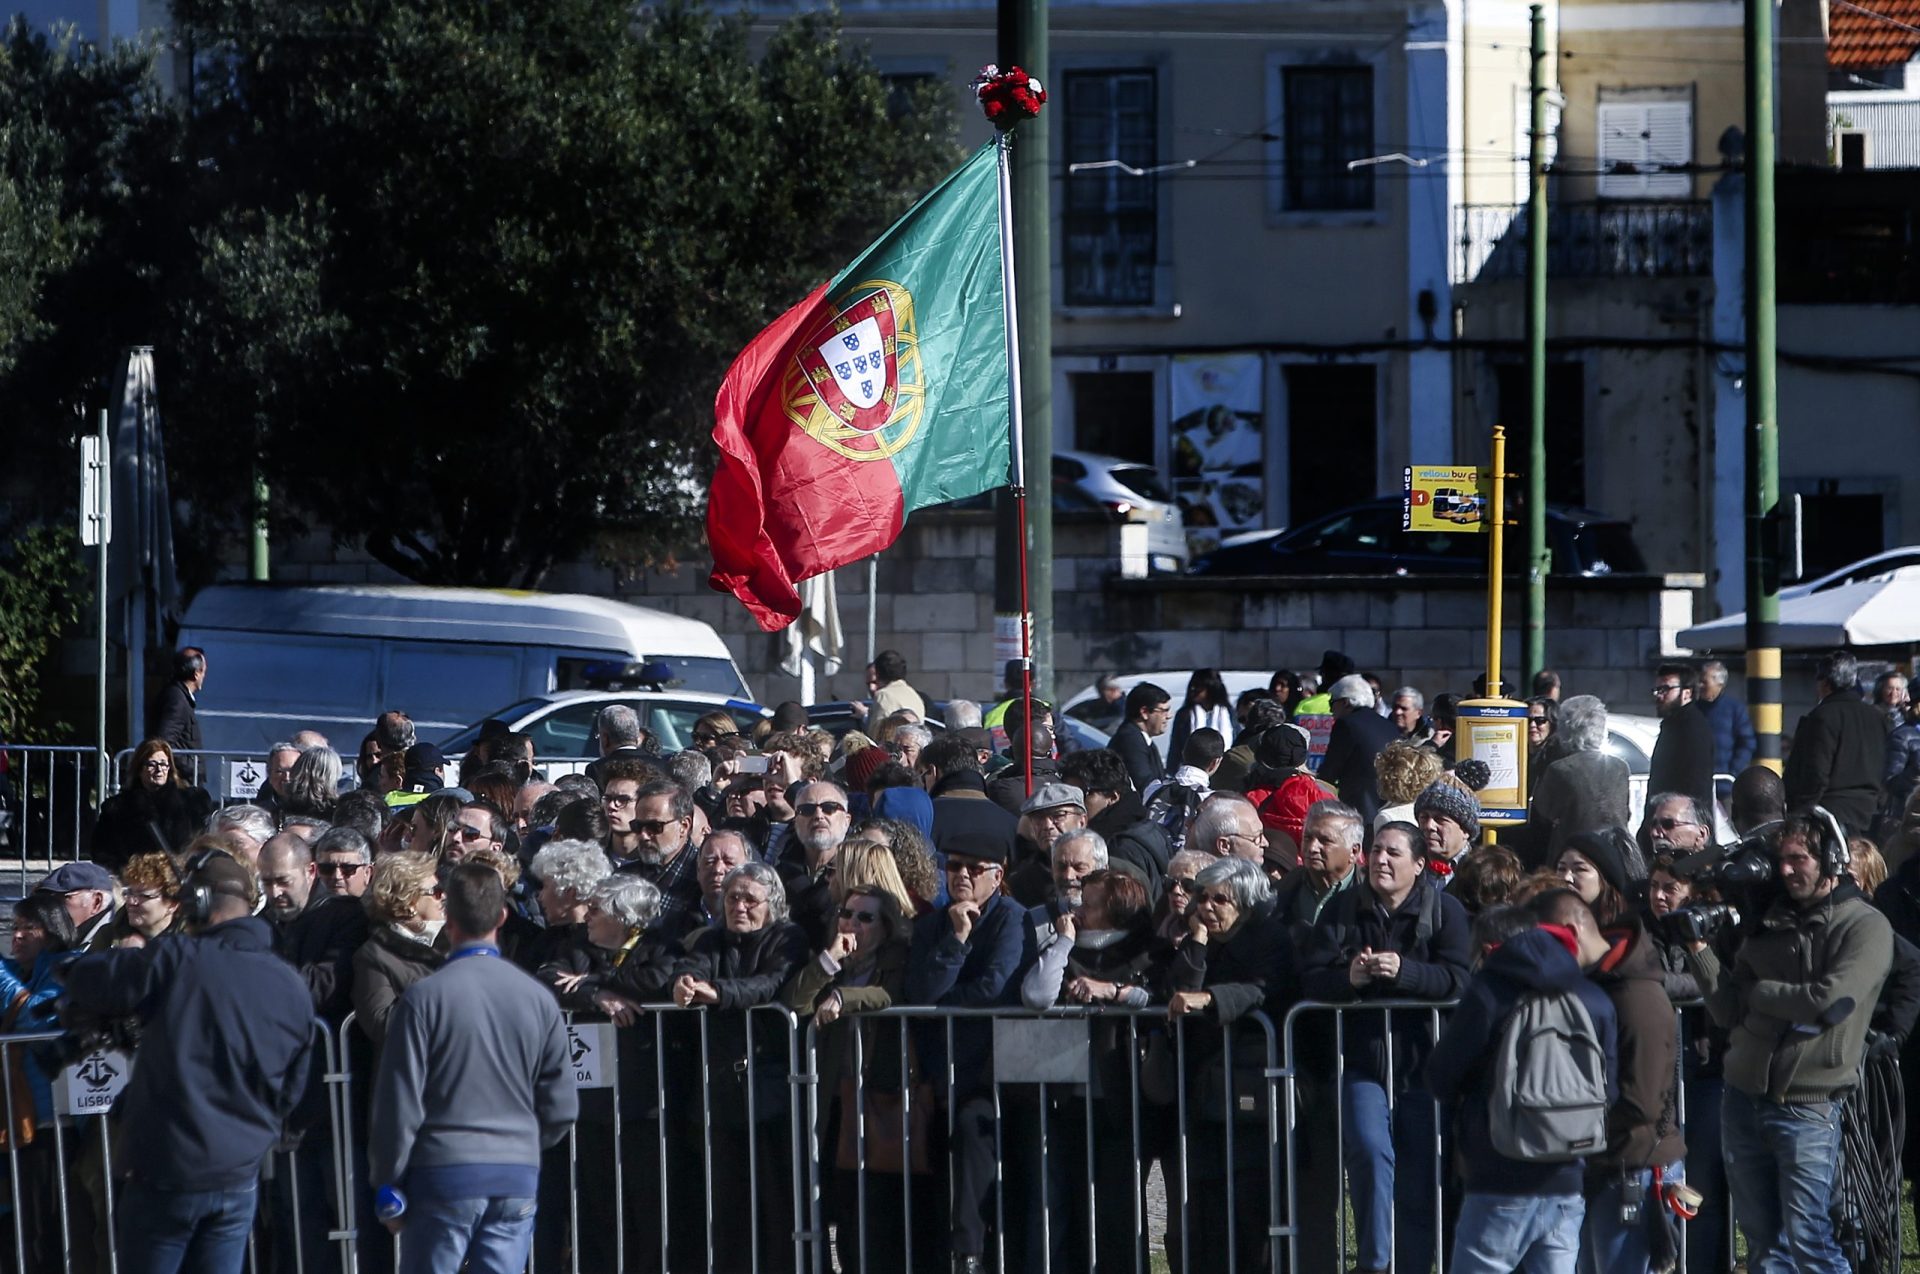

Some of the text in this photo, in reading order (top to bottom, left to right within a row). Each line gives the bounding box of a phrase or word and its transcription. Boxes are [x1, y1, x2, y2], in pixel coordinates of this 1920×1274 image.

[1451, 470, 1467, 478] bus
[1417, 494, 1424, 503] 1
[77, 1096, 112, 1108] LISBO
